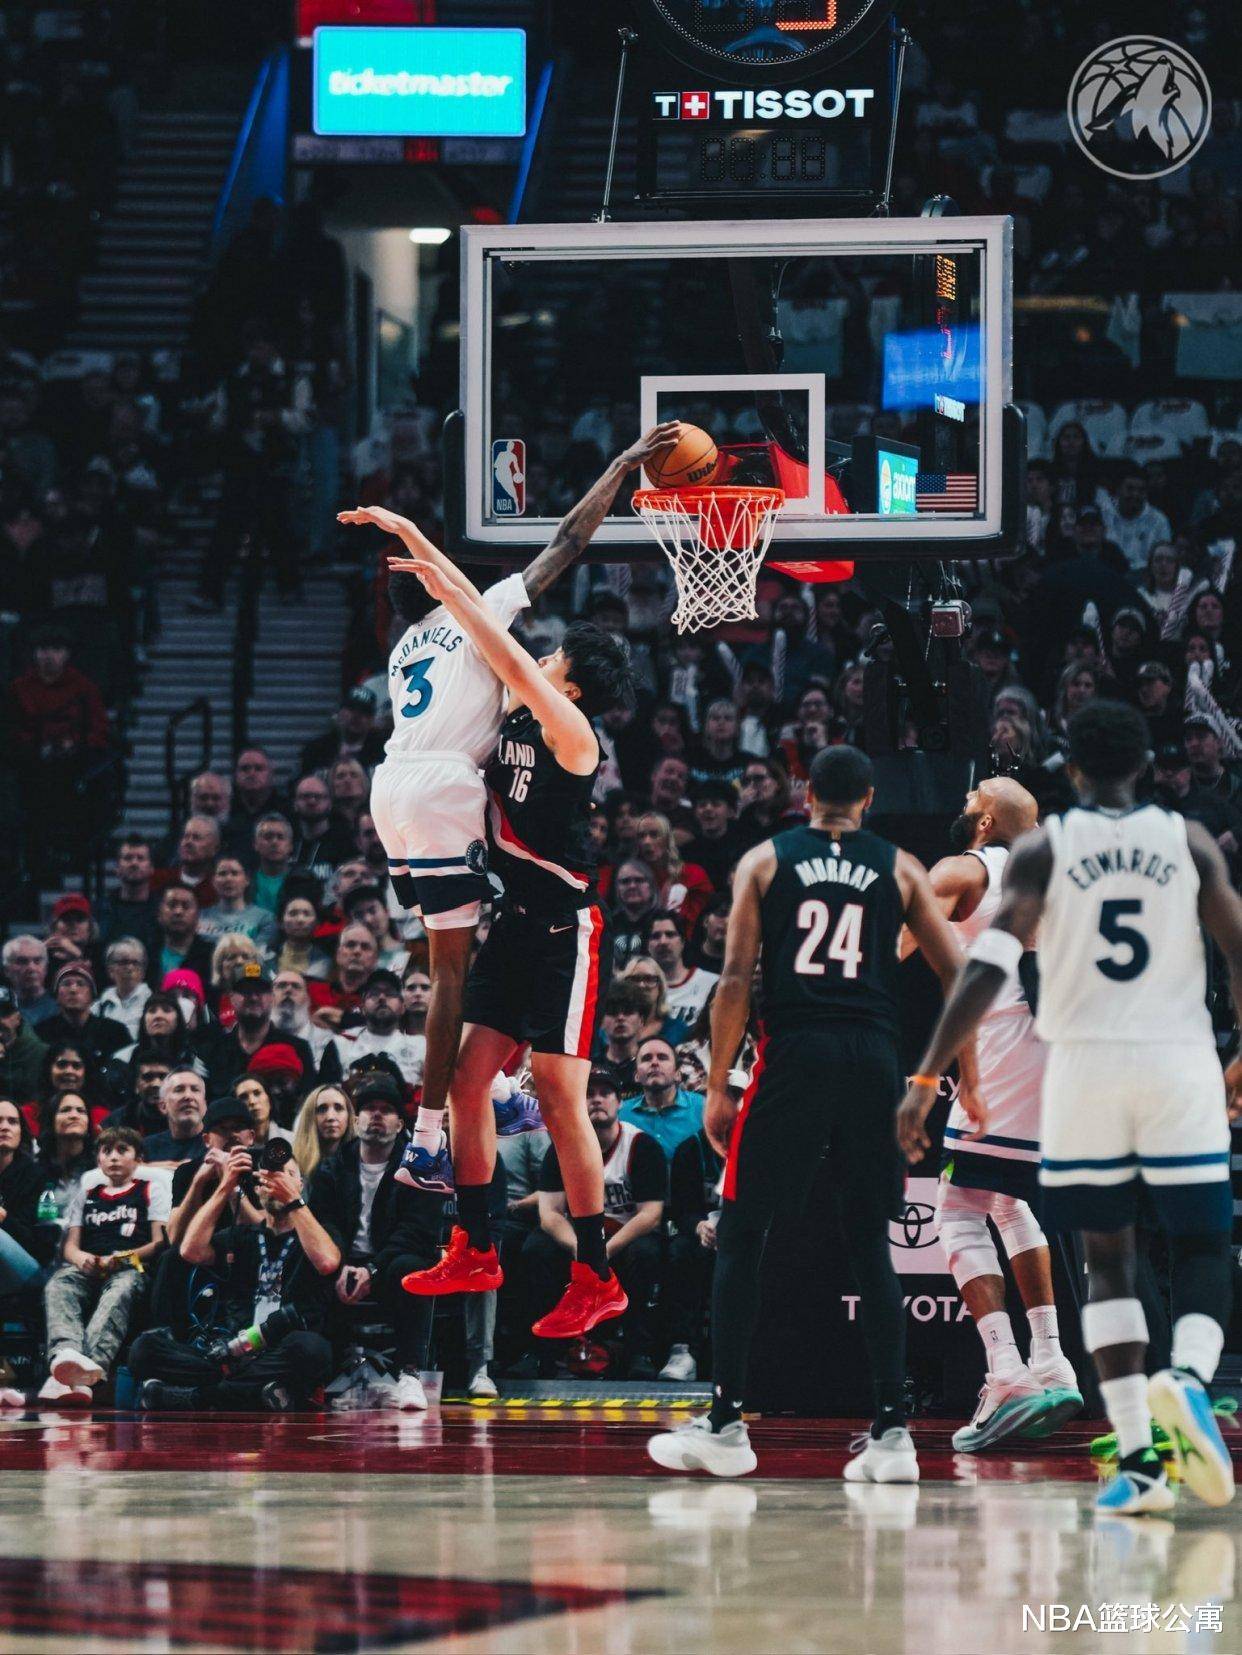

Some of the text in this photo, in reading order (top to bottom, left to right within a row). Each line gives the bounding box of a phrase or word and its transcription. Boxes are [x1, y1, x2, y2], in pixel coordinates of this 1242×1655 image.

[714, 89, 875, 120] TISSOT
[496, 498, 513, 511] NBA
[400, 656, 436, 719] 3
[508, 767, 532, 803] 16
[795, 857, 879, 892] MURRAY
[1066, 848, 1179, 891] EDWARDS
[793, 899, 865, 979] 24
[1095, 898, 1150, 983] 5
